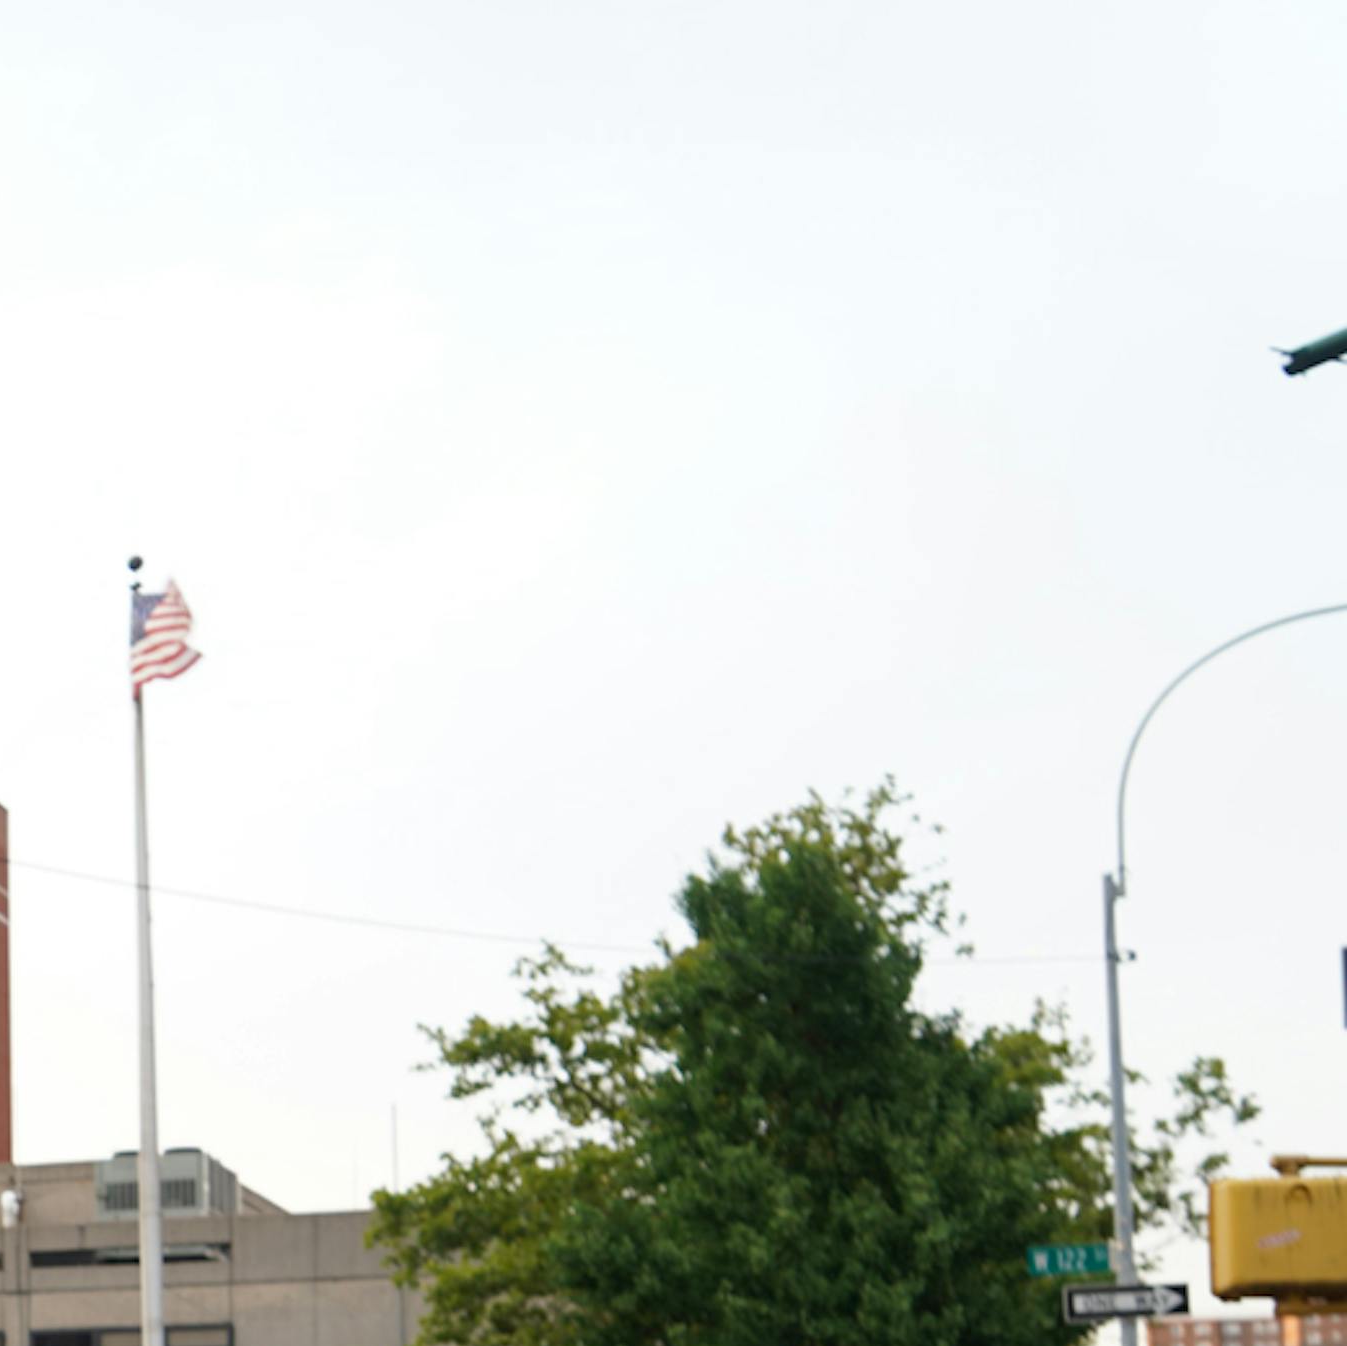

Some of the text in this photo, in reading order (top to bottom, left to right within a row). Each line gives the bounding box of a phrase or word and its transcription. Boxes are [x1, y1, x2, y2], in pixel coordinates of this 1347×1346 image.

[1035, 1249, 1048, 1271] W
[1057, 1247, 1087, 1271] 122
[1083, 1293, 1170, 1313] ONE WAY
